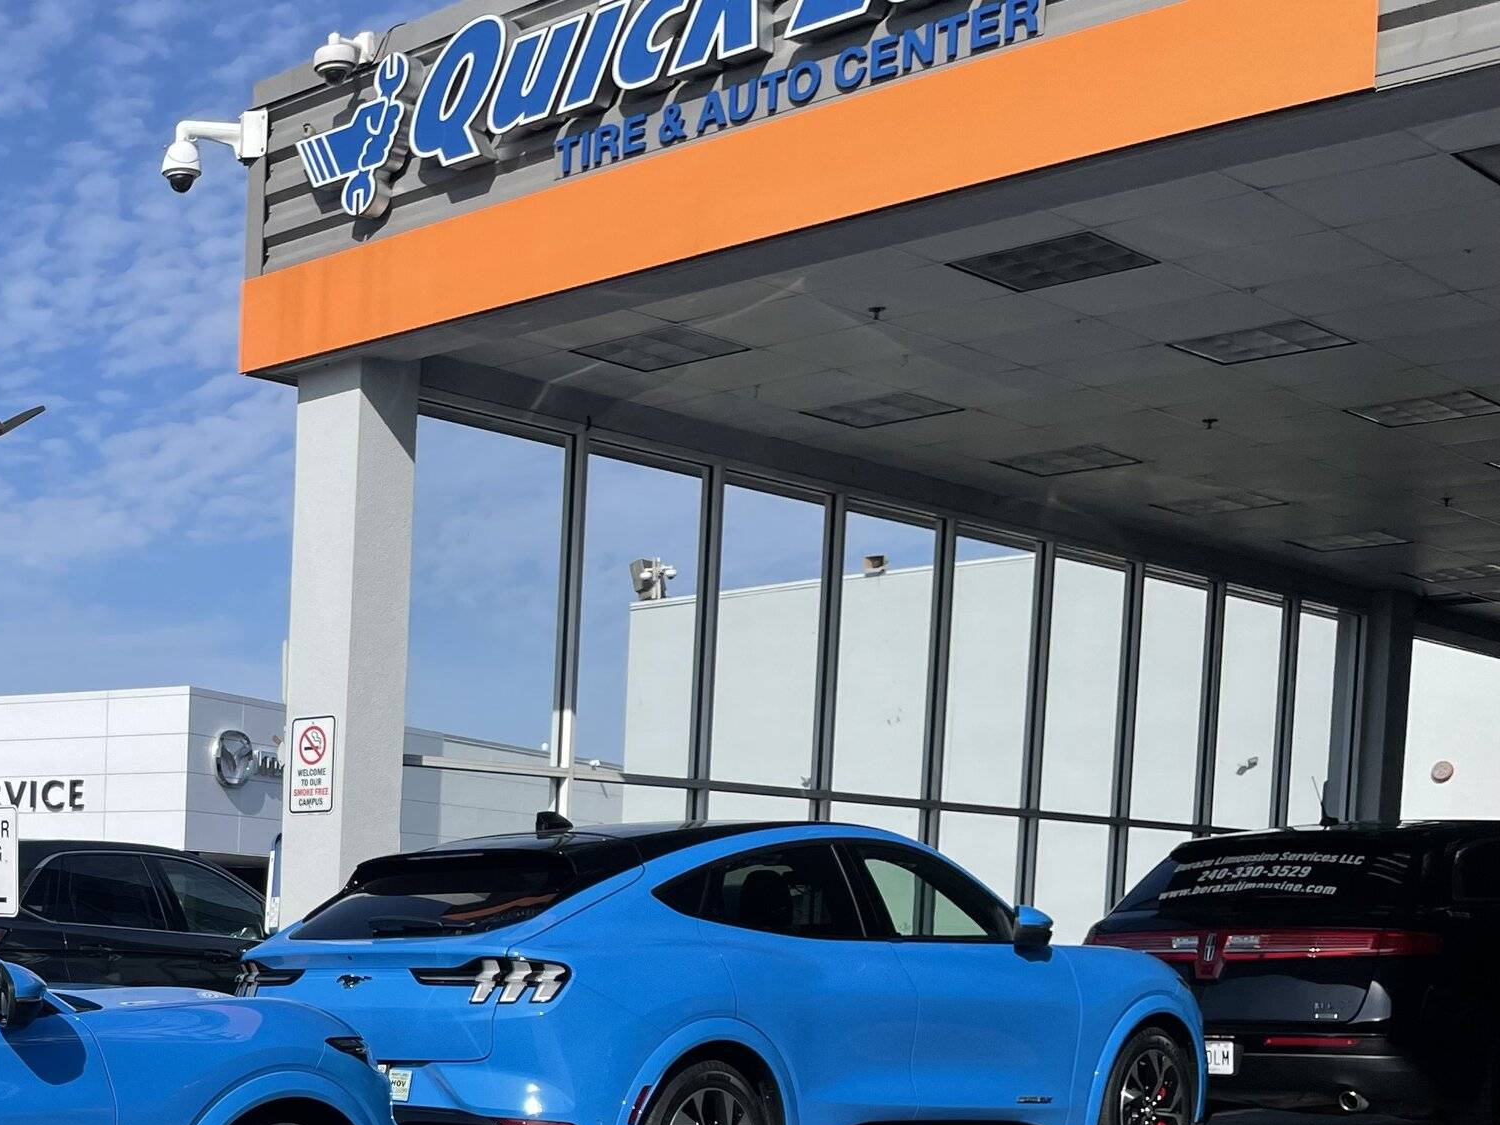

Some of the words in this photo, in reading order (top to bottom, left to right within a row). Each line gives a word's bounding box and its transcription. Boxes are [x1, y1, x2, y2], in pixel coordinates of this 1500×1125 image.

[556, 116, 648, 176] TIRE
[660, 102, 687, 141] &
[697, 60, 823, 132] AUTO
[835, 0, 1039, 90] CENTER
[297, 768, 327, 776] WELCOME
[310, 778, 322, 786] OUR
[298, 798, 323, 806] CAMPUS
[1280, 851, 1339, 863] Services
[1339, 854, 1365, 865] LLC
[1197, 865, 1312, 881] 240-330-3529
